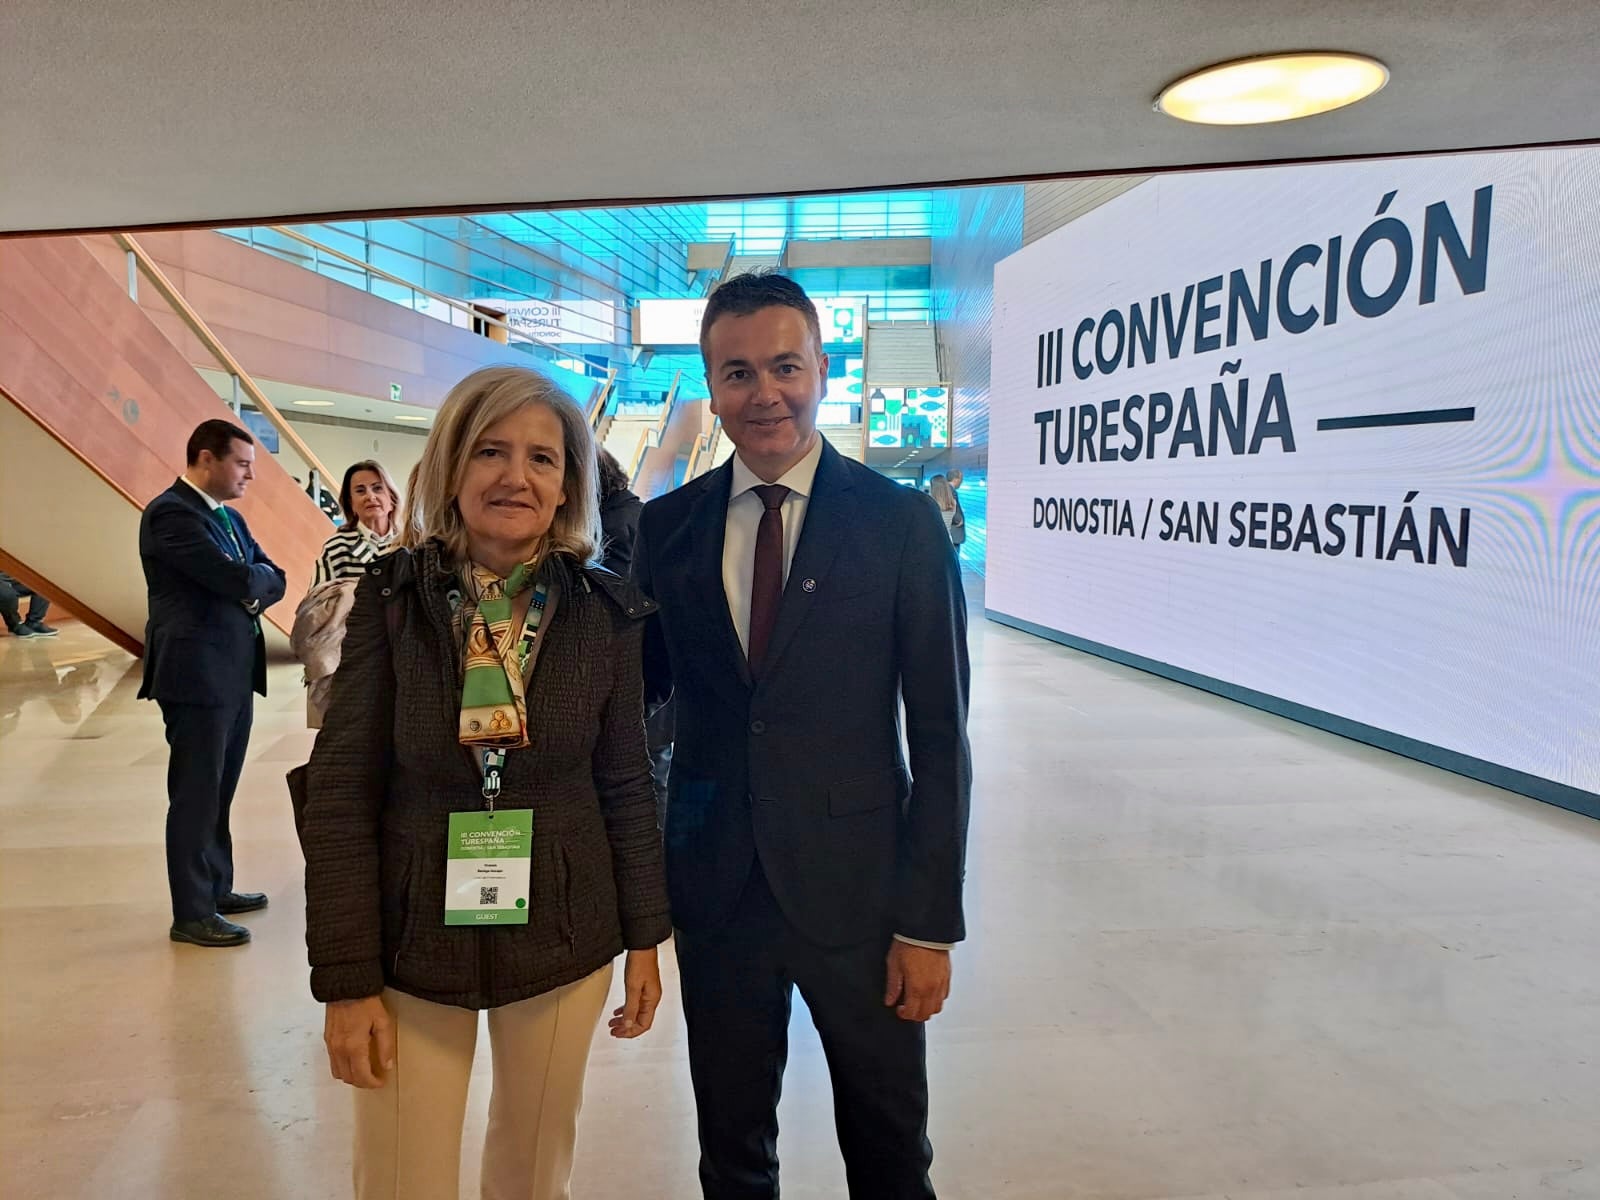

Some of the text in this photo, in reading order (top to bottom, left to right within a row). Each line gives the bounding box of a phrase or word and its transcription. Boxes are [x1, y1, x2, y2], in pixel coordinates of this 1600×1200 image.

[1037, 184, 1494, 389] III CONVENCIÓN
[1033, 358, 1297, 466] TURESPAÑA
[1033, 490, 1471, 568] DONOSTIA / SAN SEBASTIÁN
